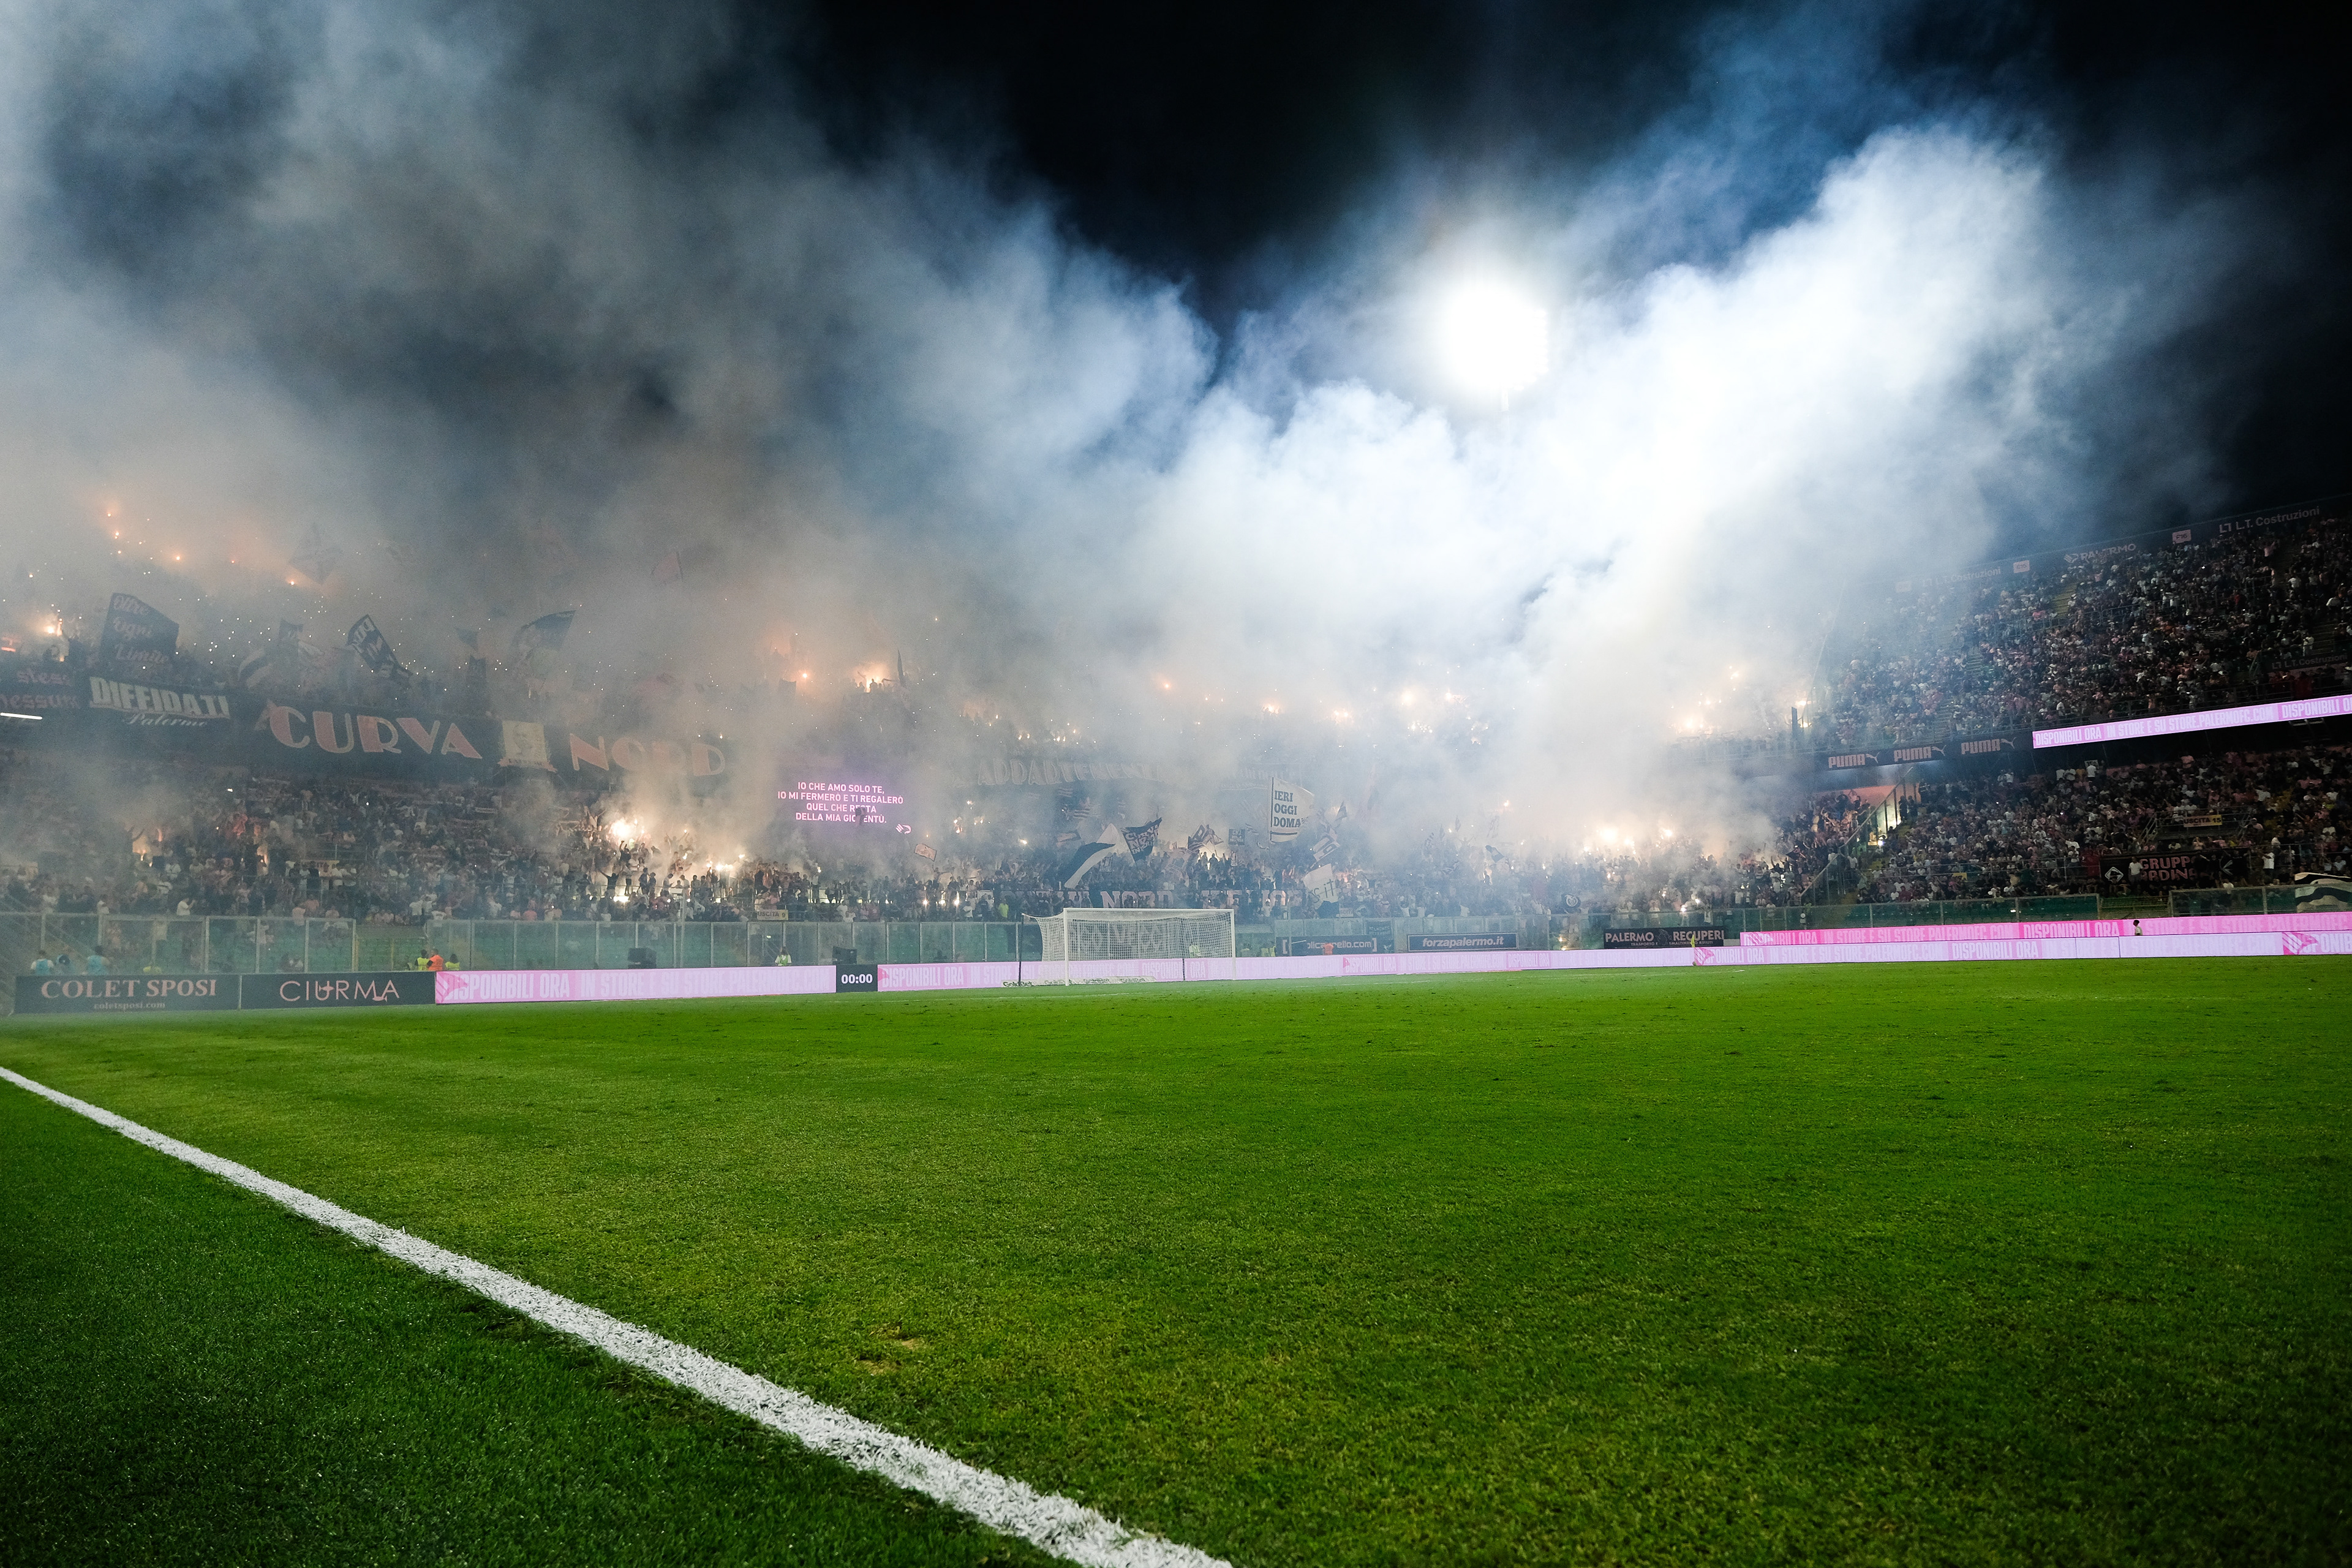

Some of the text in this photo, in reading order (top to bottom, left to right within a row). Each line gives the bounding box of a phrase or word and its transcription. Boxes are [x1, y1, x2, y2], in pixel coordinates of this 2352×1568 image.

[2255, 506, 2320, 527] Costruzioni
[89, 676, 230, 718] DIFFIDATI
[123, 712, 208, 727] Palermo
[2035, 730, 2082, 745] DISPONIBILI
[2084, 728, 2101, 741] ORA
[2106, 726, 2114, 738] IN
[2119, 723, 2144, 737] STORE
[2147, 722, 2152, 733] E
[2155, 720, 2166, 733] SU
[2169, 706, 2273, 731] STORE.PALERMOFC.COM
[2282, 699, 2340, 718] DISPONIBILI
[270, 706, 483, 759] CURVA
[569, 733, 726, 777] NORD
[1961, 739, 2000, 755] PUMA
[1828, 753, 1866, 769] PUMA
[1894, 746, 1932, 762] PUMA
[797, 781, 885, 794] IO CHE AMO SOLO TE,
[777, 791, 787, 799] IO
[800, 792, 842, 801] FERMERÒ
[860, 794, 904, 804] REGALERÒ
[1274, 790, 1294, 802] IERI
[806, 802, 829, 812] QUEL
[831, 804, 848, 812] CHE
[1273, 803, 1298, 815] OGGI
[795, 812, 887, 824] DELLA MIA GIOENTÙ.
[1605, 930, 1724, 943] PALERMO RECUPERI
[2024, 922, 2090, 938] DISPONIBILI
[2095, 921, 2119, 937] ORA
[1422, 936, 1504, 948] forzapalermo.it
[1798, 932, 1817, 944] ORA
[1747, 948, 1765, 963] ORA
[1769, 948, 1779, 962] IN
[1782, 946, 1809, 962] STORE
[1819, 946, 1831, 962] SU
[1952, 942, 2013, 959] DISPONIBILI
[2016, 941, 2038, 958] ORA
[1191, 960, 1205, 978] ORA
[1384, 957, 1396, 971] ORA
[540, 972, 570, 998] ORA
[581, 972, 595, 998] IN
[600, 971, 644, 998] STORE
[649, 971, 655, 997] E
[660, 970, 679, 996] SU
[841, 974, 873, 984] 00:00
[944, 967, 964, 986] ORA
[970, 966, 981, 986] IN
[40, 978, 217, 998] COLET SPOSI
[280, 979, 399, 1001] CIURMA
[94, 1001, 165, 1011] coletsposi.com
